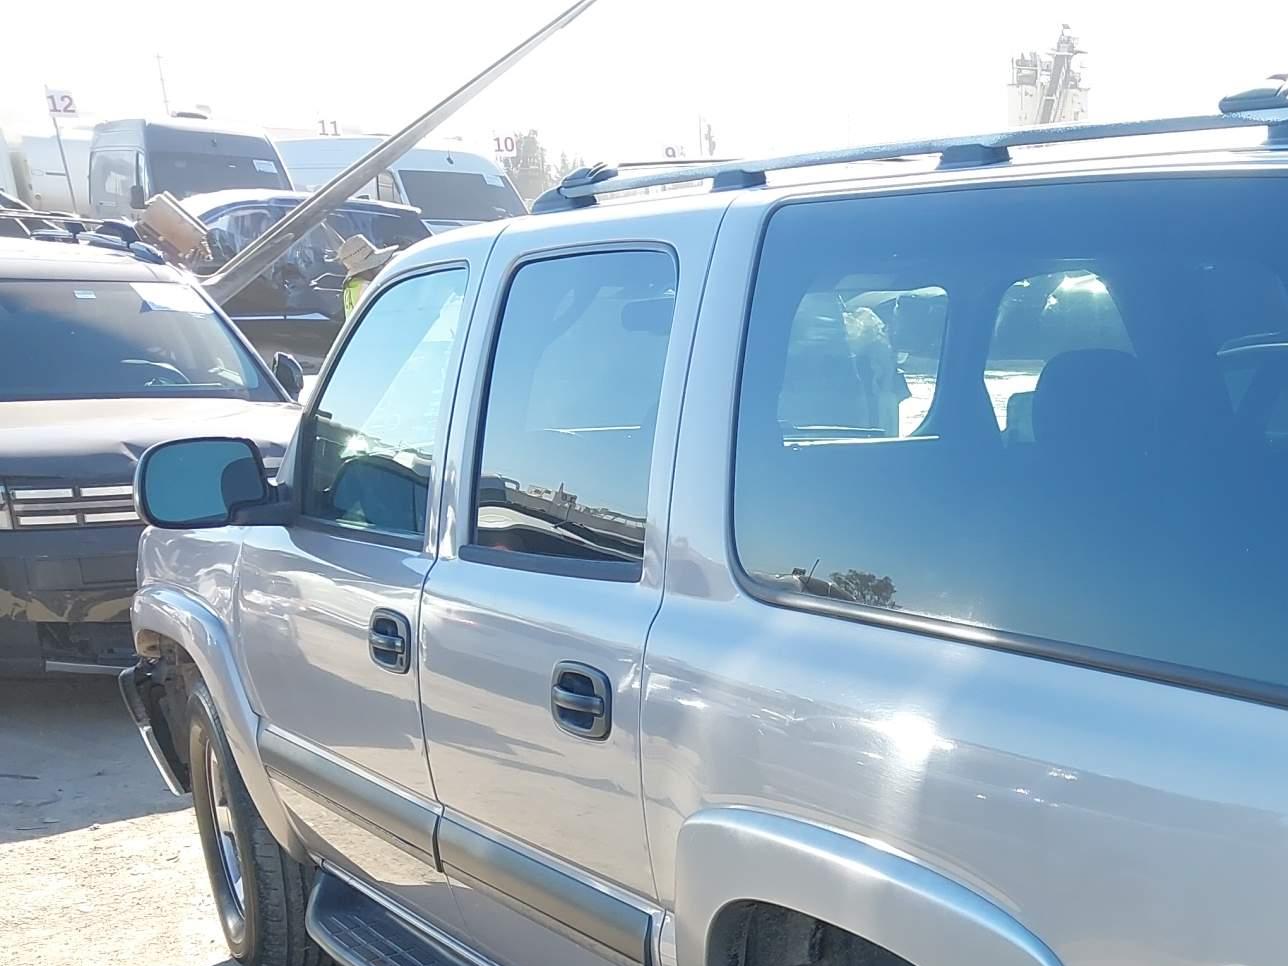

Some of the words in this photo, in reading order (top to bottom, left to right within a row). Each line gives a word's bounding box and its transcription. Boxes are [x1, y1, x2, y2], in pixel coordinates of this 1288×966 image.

[46, 94, 77, 114] 12
[317, 119, 341, 137] 11
[492, 136, 515, 153] 10
